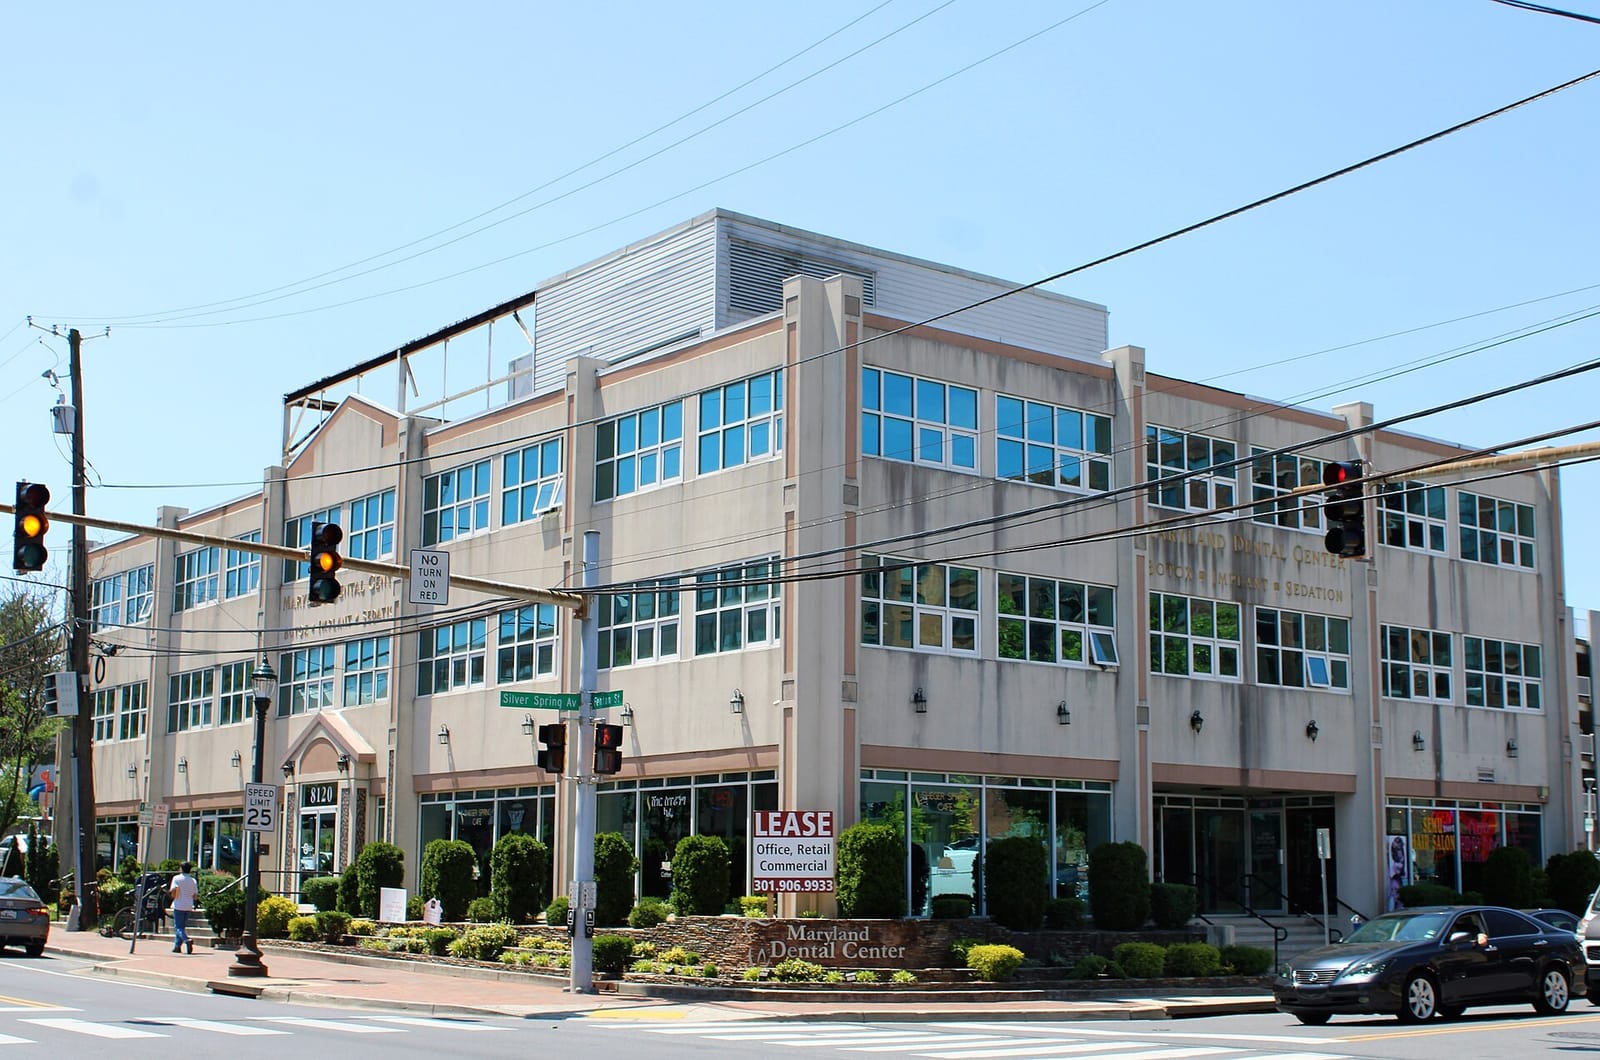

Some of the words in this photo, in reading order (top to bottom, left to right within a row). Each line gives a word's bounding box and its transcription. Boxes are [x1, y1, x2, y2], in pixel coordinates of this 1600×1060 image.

[421, 555, 439, 565] NO
[418, 568, 442, 577] TURN
[423, 580, 436, 588] ON
[420, 591, 438, 600] RED
[1286, 581, 1344, 602] SEDATION
[503, 694, 529, 705] Silver
[533, 697, 562, 709] Spring
[566, 698, 577, 708] Av
[614, 694, 620, 703] St
[248, 788, 274, 797] SPEED
[310, 786, 333, 803] 8120
[250, 799, 271, 807] LIMIT
[247, 808, 272, 826] 25
[755, 812, 831, 836] LEASE
[1433, 834, 1455, 850] SALON
[757, 843, 793, 856] Office,
[797, 843, 830, 855] Retail
[760, 860, 827, 871] Commercial
[754, 880, 833, 892] 301.906.9933
[787, 925, 869, 946] Maryland
[770, 940, 835, 959] Dental
[842, 941, 905, 959] Center
